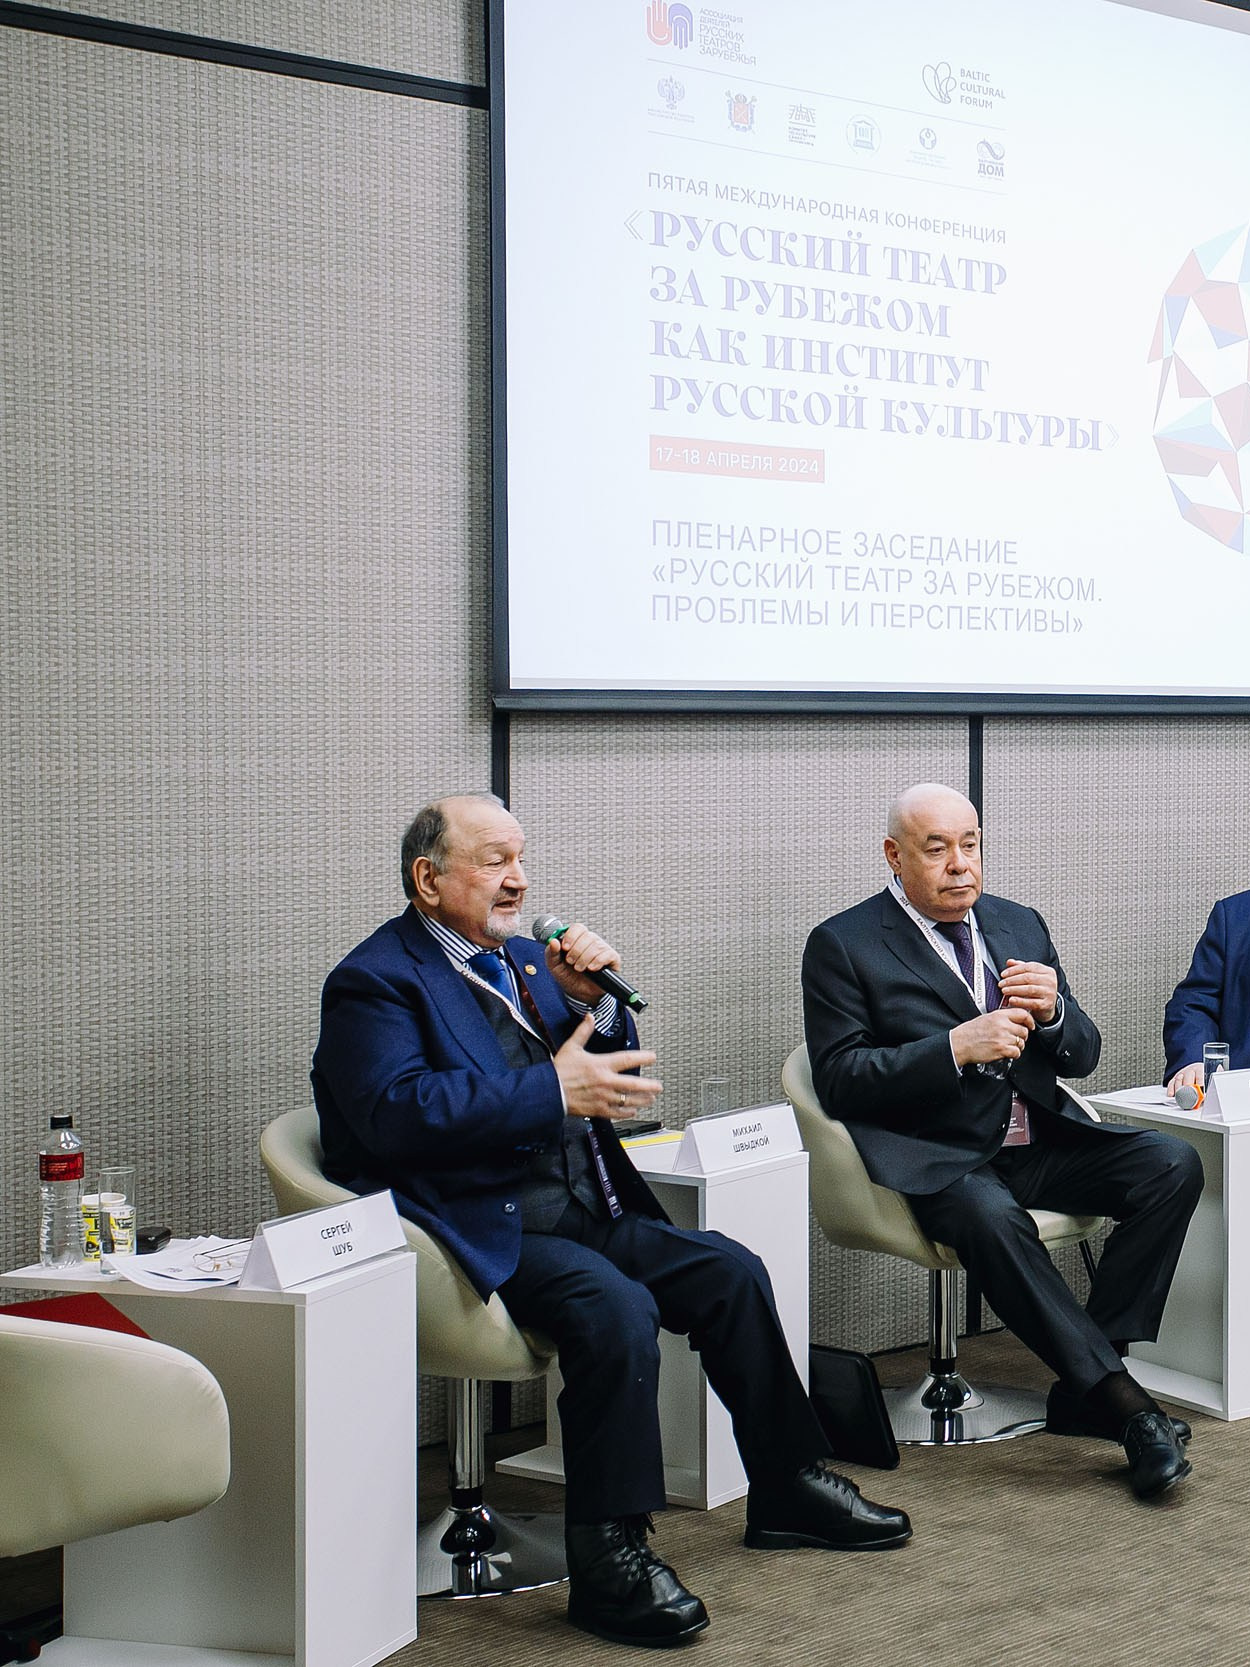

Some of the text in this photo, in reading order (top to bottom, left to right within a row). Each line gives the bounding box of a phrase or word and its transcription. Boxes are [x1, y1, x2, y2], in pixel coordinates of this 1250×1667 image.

[699, 34, 741, 52] ТЕАТРОВ
[700, 24, 744, 42] РУССКИХ
[699, 45, 757, 65] ЗАРУБЕЖЬЯ
[960, 68, 990, 83] BALTIC
[960, 82, 1006, 99] CULTURAL
[960, 96, 993, 110] FORUM
[978, 163, 1005, 178] ДОМ
[648, 172, 1006, 244] ПЯТАЯ МЕЖДУНАРОДНАЯ КОНФЕРЕНЦИЯ
[883, 246, 1007, 295] ТЕАТР
[649, 265, 951, 338] ЗА РУБЕЖОМ
[649, 319, 990, 392] КАК ИНСТИТУТ
[649, 374, 868, 430] РУССКОЙ
[655, 447, 820, 475] 17-18 АПРЕЛЯ 2024
[652, 519, 1018, 566] ПЛЕНАРНОЕ ЗАСЕДАНИЕ
[652, 557, 1103, 603] «РУССКИЙ ТЕАТР ЗА РУБЕЖОМ.
[652, 594, 1083, 634] ПРОБЛЕМЫ И ПЕРСПЕКТИВЫ»
[732, 1122, 763, 1137] МИХАИЛ
[733, 1135, 770, 1153] ШВЫДКОЙ
[320, 1220, 353, 1240] СЕРГЕЙ
[331, 1241, 353, 1257] ШУБ
